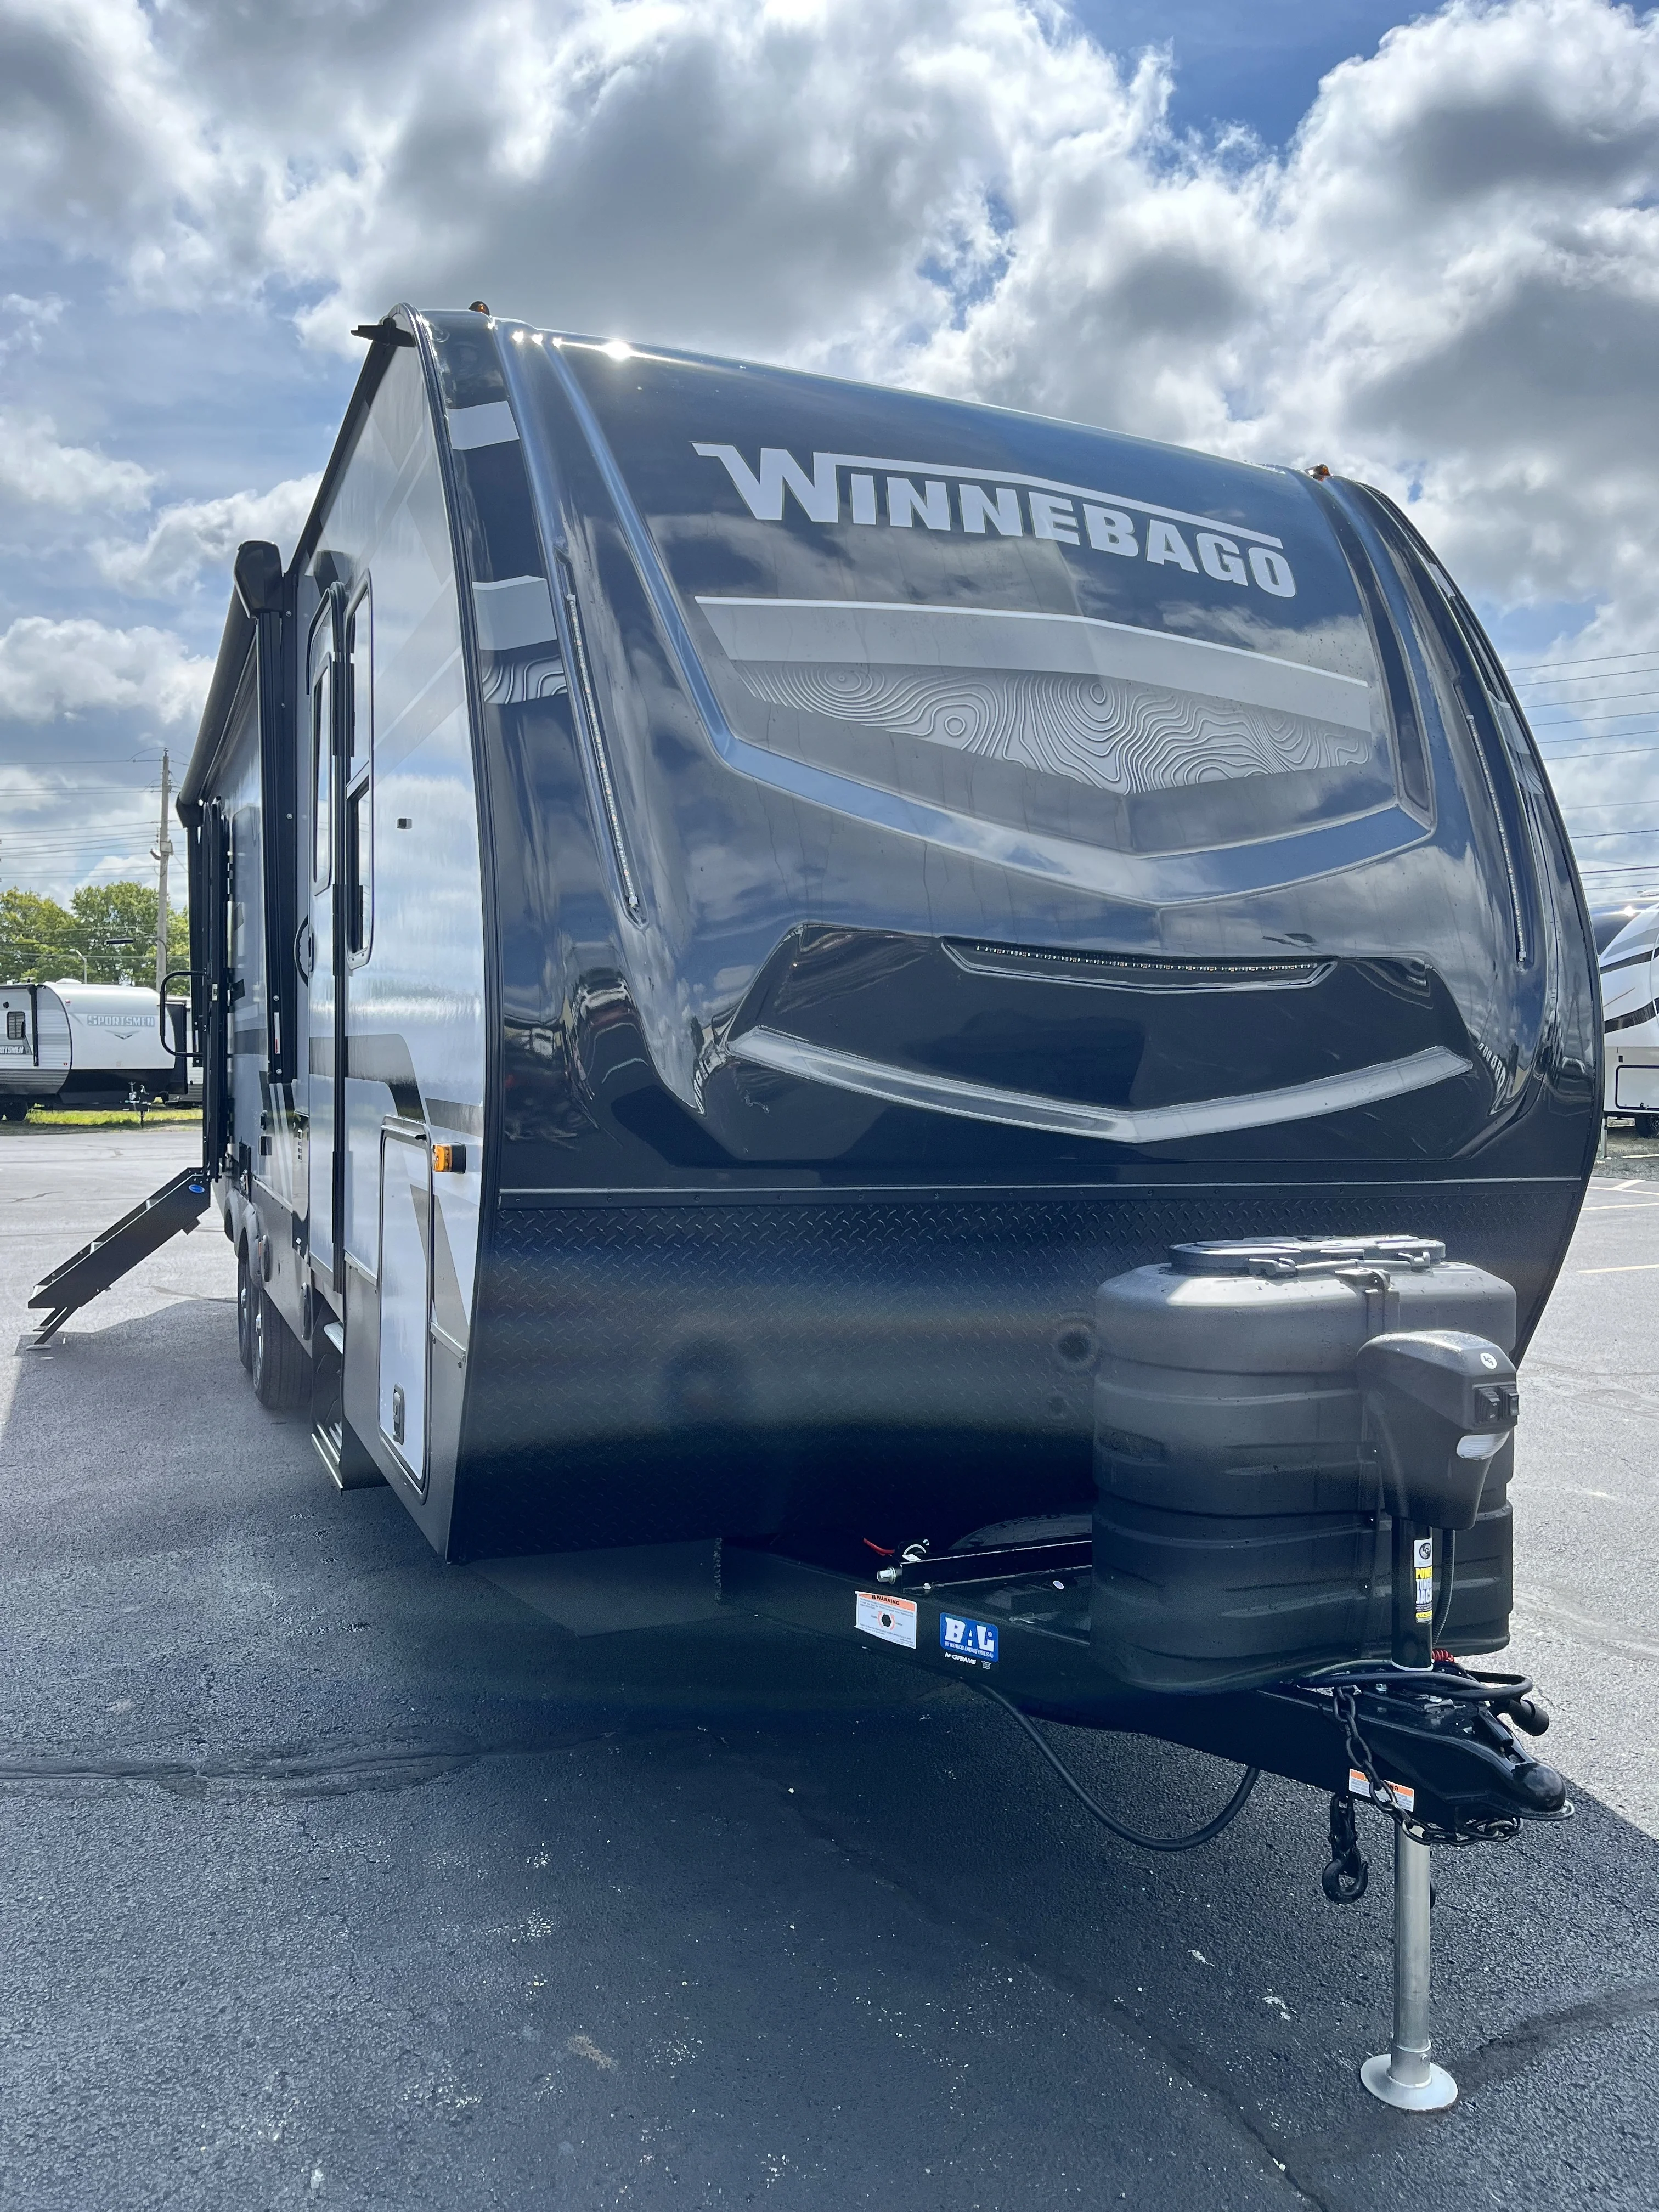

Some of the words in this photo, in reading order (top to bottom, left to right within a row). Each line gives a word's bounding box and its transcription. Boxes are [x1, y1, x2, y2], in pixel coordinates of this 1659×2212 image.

[692, 442, 1296, 598] WINNEBAGO
[88, 1014, 154, 1026] SPORTSMEN
[0, 1046, 24, 1054] RTSMEN
[877, 1595, 900, 1606] WARNING
[945, 1617, 995, 1652] BAL
[950, 1642, 964, 1651] NORCO
[964, 1646, 989, 1657] INDUSTRIES
[957, 1655, 977, 1665] FRAME
